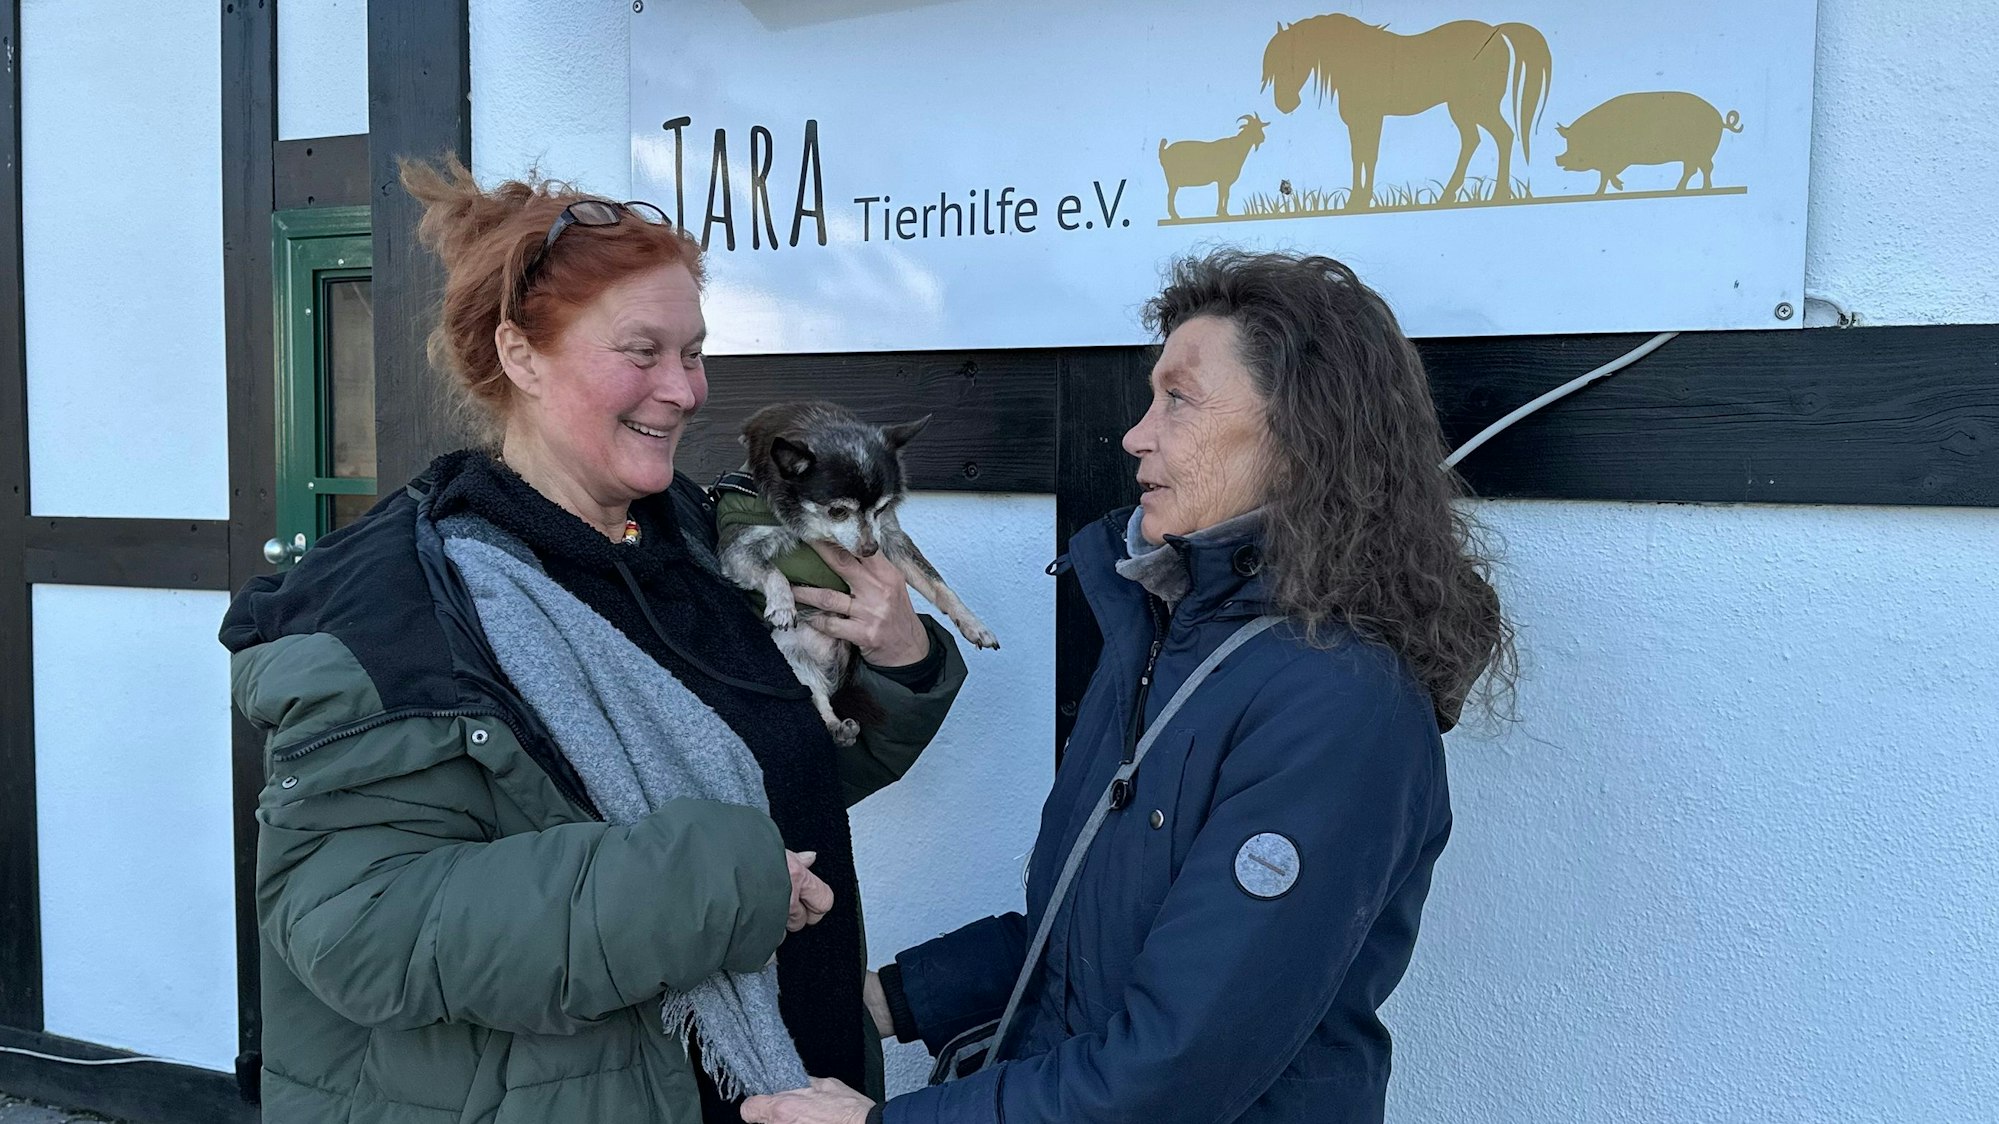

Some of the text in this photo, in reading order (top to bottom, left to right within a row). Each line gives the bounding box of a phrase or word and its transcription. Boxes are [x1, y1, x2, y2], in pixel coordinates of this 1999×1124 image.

[662, 116, 1131, 251] TARA Tierhilfe e.V.
